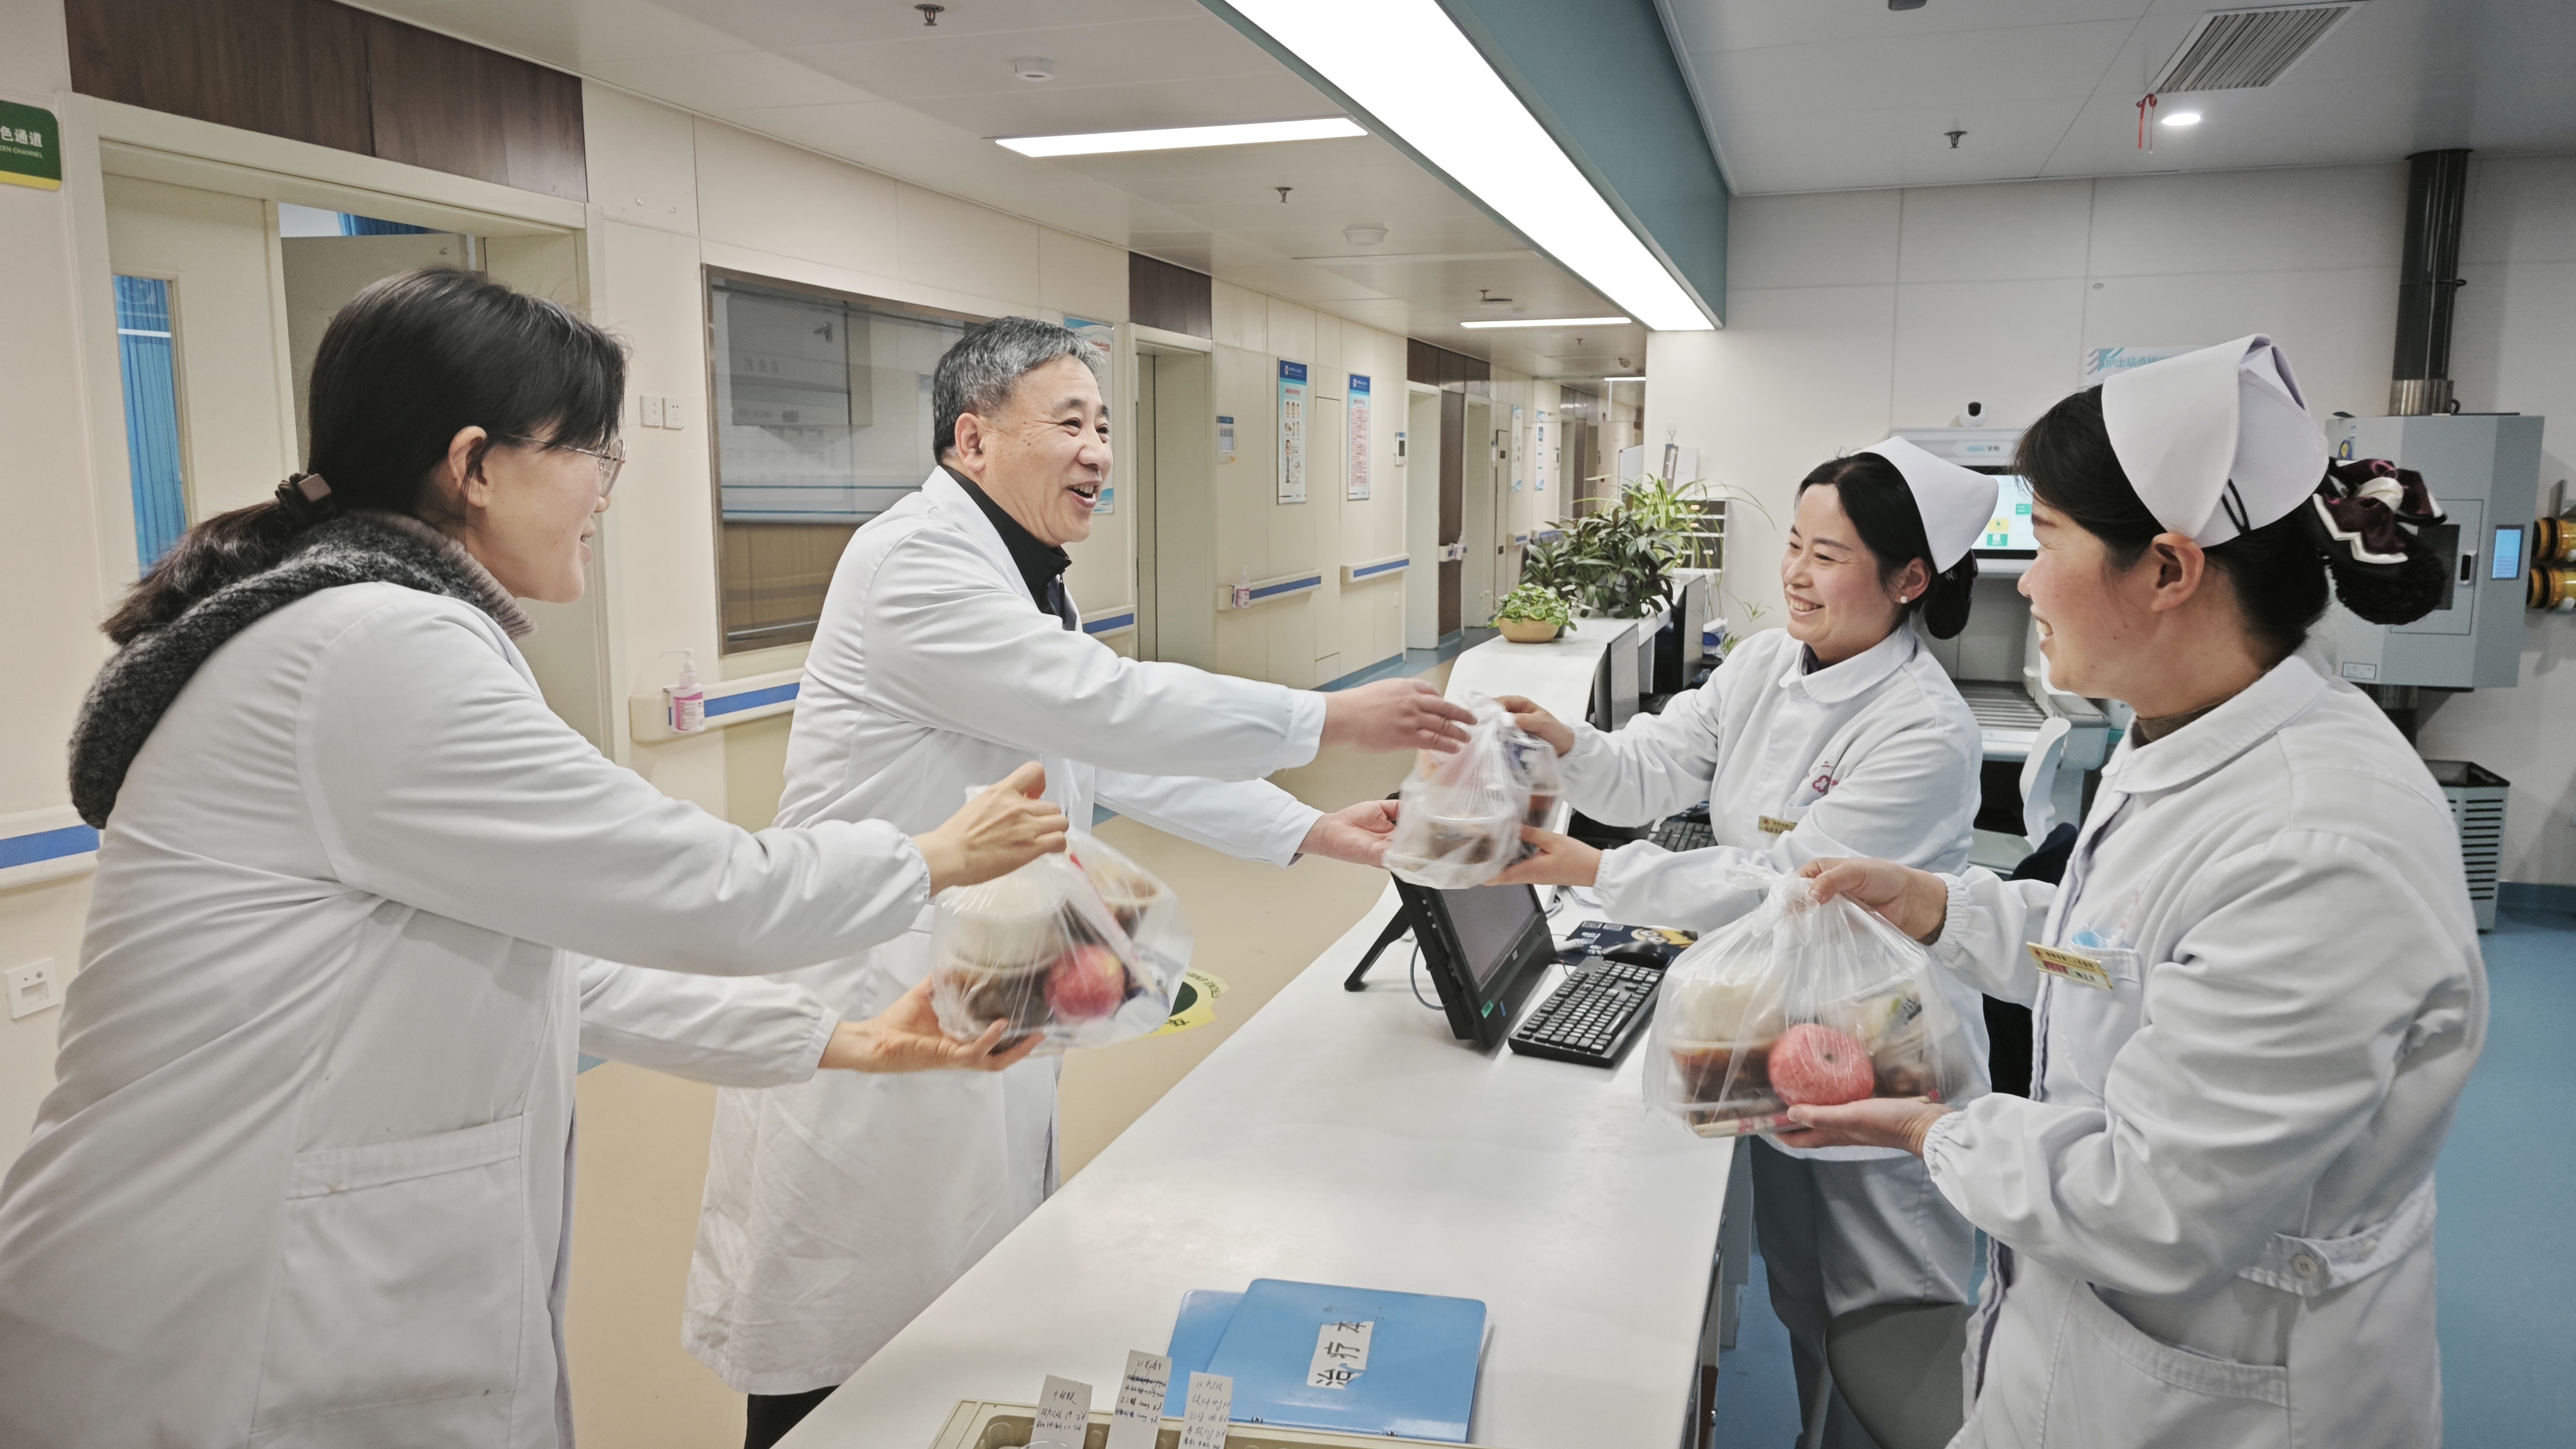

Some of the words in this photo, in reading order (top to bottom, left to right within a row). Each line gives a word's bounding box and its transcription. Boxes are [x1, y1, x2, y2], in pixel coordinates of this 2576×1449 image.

[1, 126, 43, 147] 色通道
[13, 147, 43, 158] CHANNEL
[1316, 1321, 1366, 1386] 治疗本
